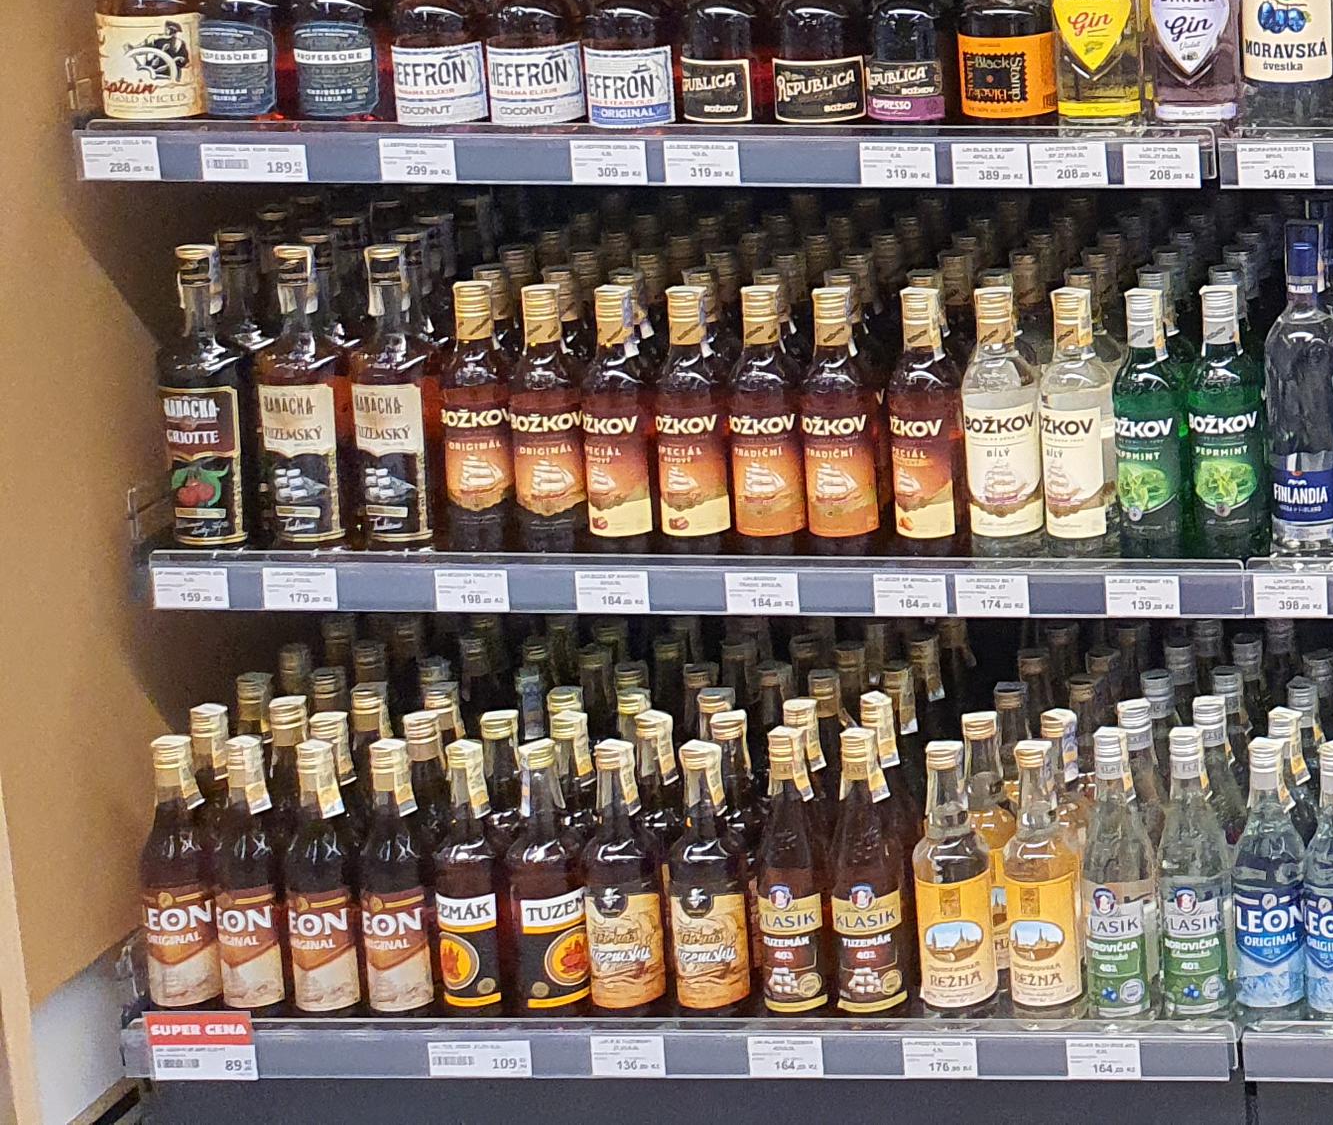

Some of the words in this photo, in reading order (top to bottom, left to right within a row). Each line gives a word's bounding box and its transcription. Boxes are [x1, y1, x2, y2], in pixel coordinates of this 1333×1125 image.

[1067, 12, 1113, 37] Gin
[1164, 15, 1213, 42] Gin
[1245, 38, 1328, 59] MORAVSKÁ
[976, 56, 1010, 69] Black
[776, 69, 855, 103] REPUBLICA
[400, 104, 451, 116] COCONUT
[500, 104, 555, 115] COCONUT
[872, 100, 911, 110] ESPRESSO
[600, 108, 656, 118] ORIGINAL
[965, 412, 1035, 434] BOŽKOV
[519, 444, 573, 455] ORIGINÁL
[1274, 484, 1328, 504] FINLANDIA
[1236, 905, 1301, 932] LEON
[1244, 933, 1298, 947] ORIGINAL
[150, 1023, 202, 1037] SUPER
[205, 1024, 248, 1037] CENA
[225, 1059, 242, 1071] 89
[491, 1058, 517, 1070] 109
